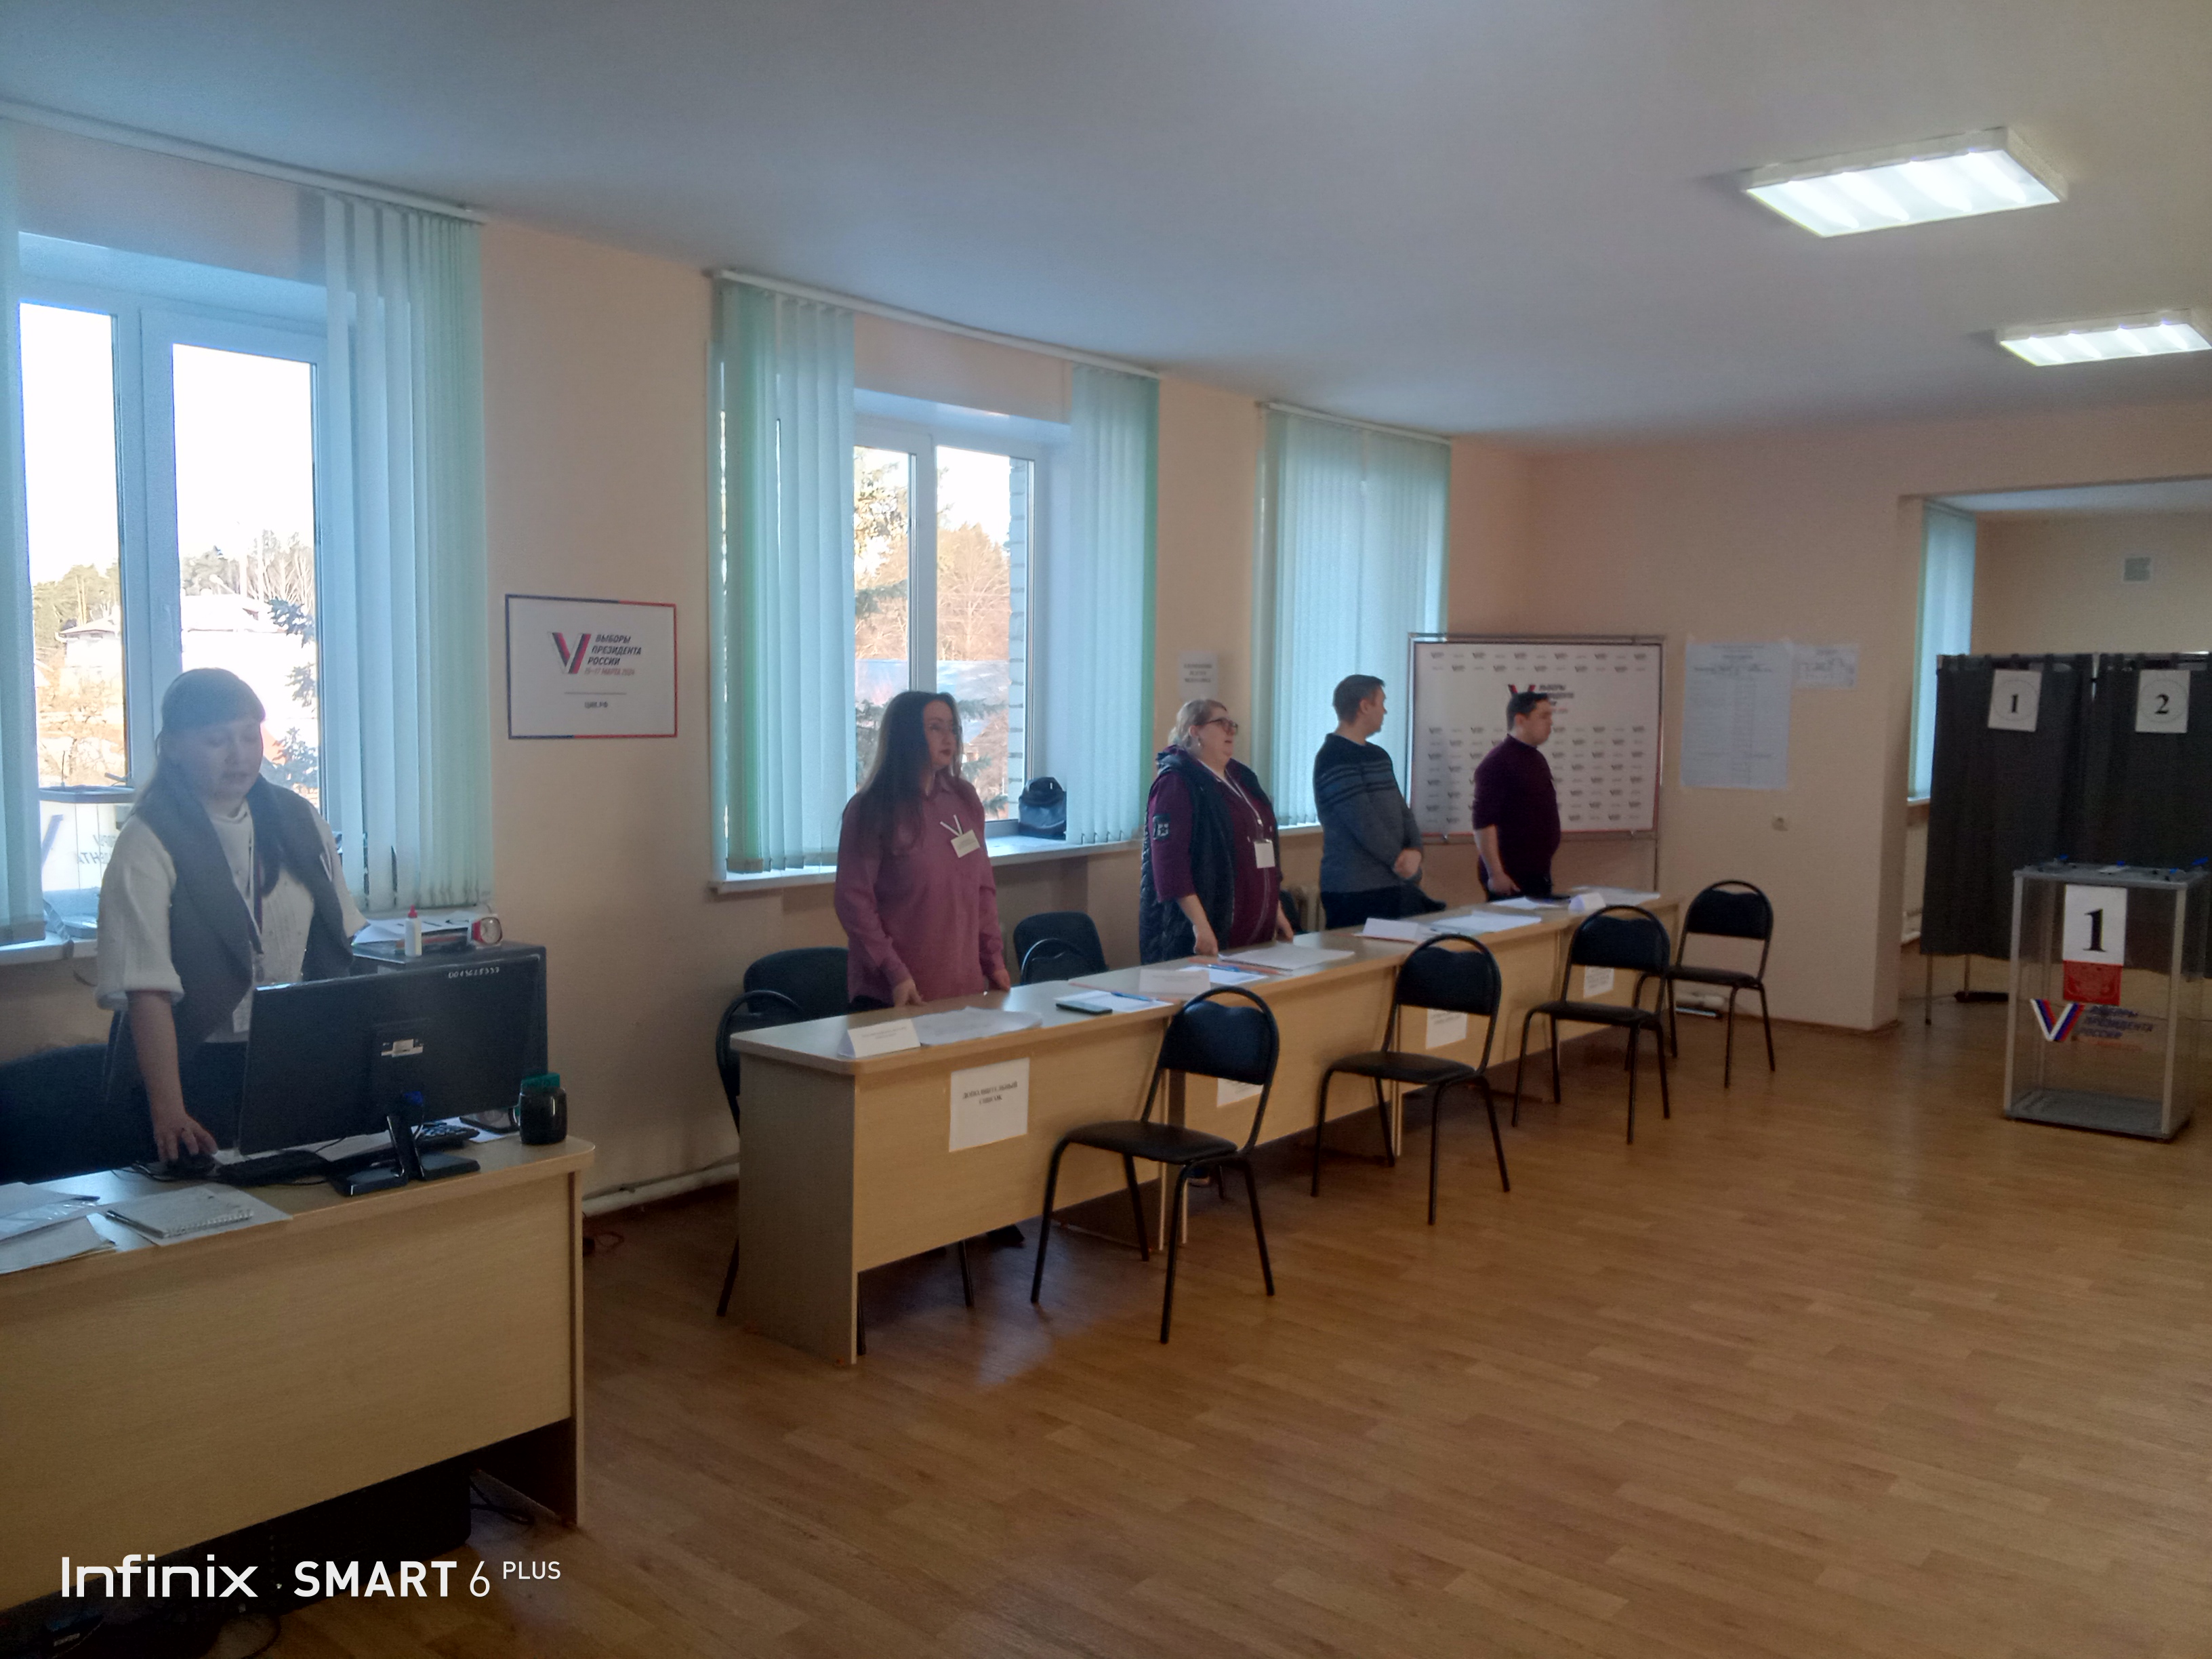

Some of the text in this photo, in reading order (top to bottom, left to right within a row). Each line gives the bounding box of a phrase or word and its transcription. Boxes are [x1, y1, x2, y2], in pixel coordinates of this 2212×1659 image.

[596, 634, 631, 644] ВЫБОРЫ
[592, 646, 642, 656] ПРЕЗИДЕНТА
[588, 657, 620, 665] РОССИИ
[2011, 694, 2018, 714] 1
[2154, 693, 2169, 714] 2
[2083, 909, 2106, 952] 1
